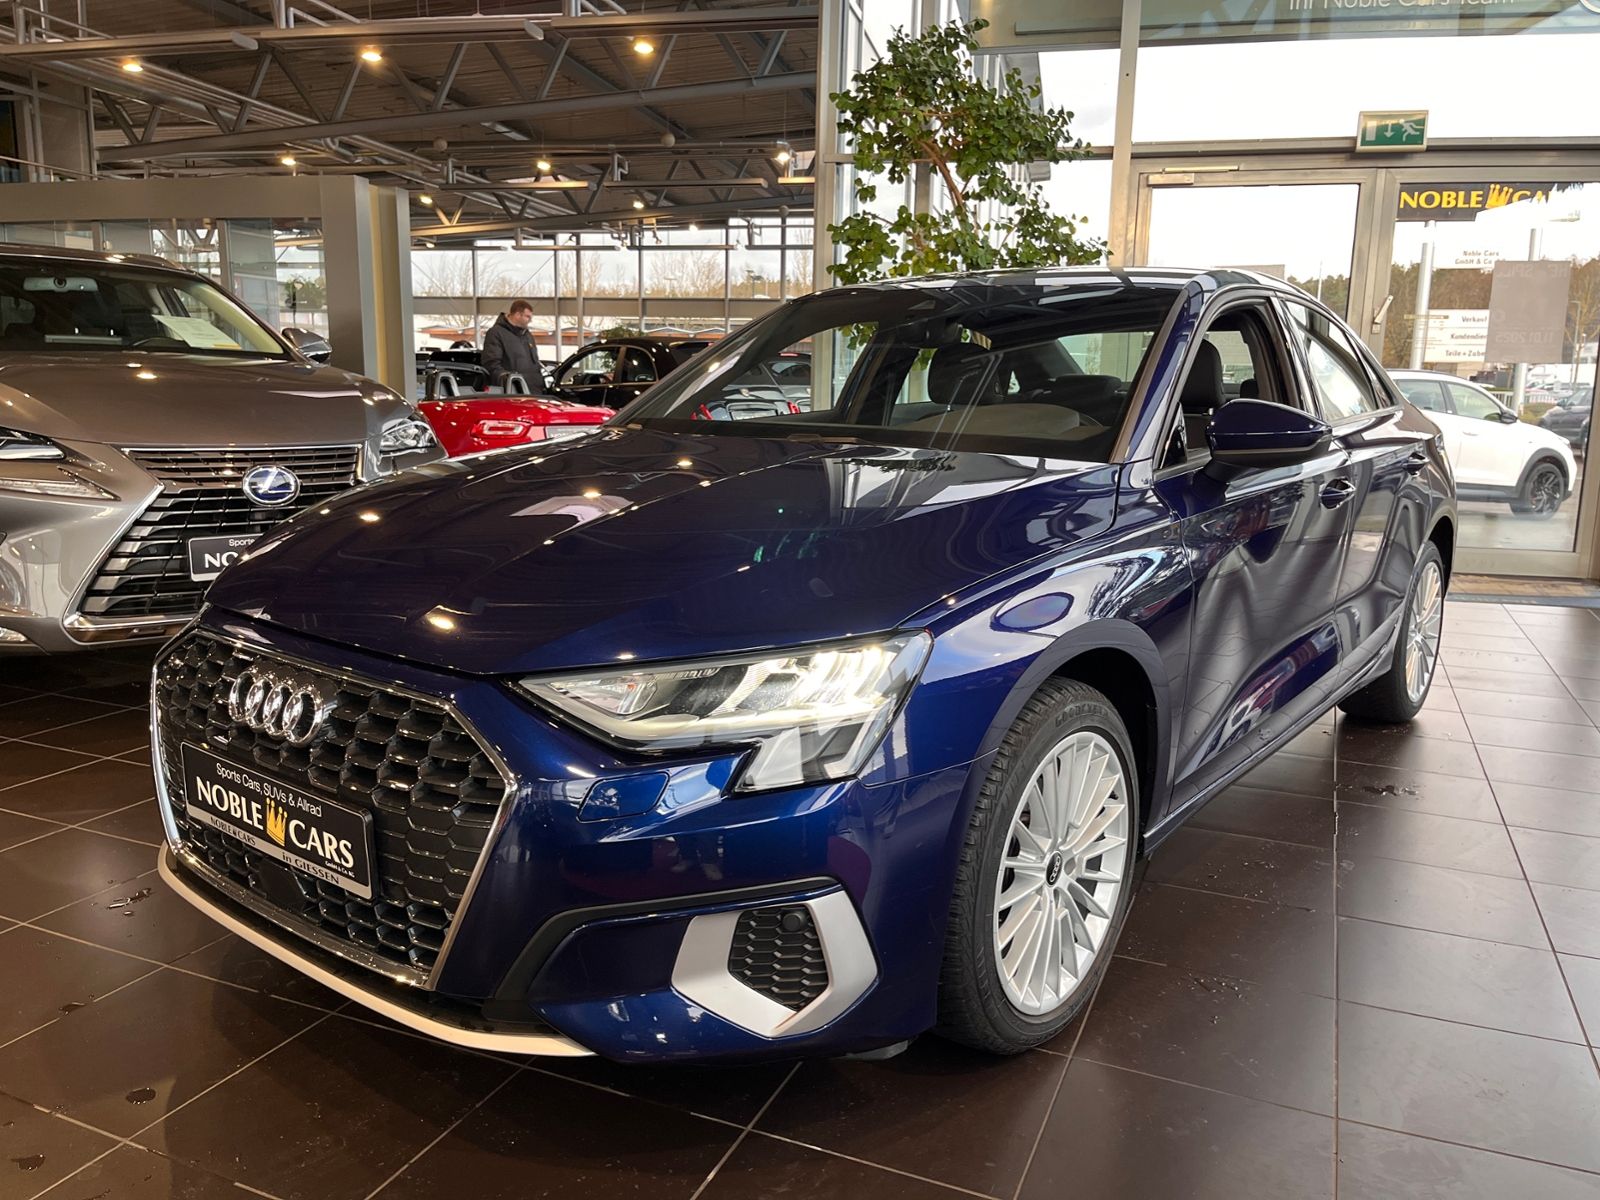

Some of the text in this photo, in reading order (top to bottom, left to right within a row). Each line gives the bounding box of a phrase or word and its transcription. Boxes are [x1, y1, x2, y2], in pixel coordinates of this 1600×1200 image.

[1400, 191, 1483, 208] NOBLE
[217, 762, 322, 818] Sports Cars, SUVs & Allrad
[196, 776, 354, 869] NOBLE CARS
[210, 816, 256, 846] NOBLE CARS
[282, 851, 340, 885] in GIESSEN
